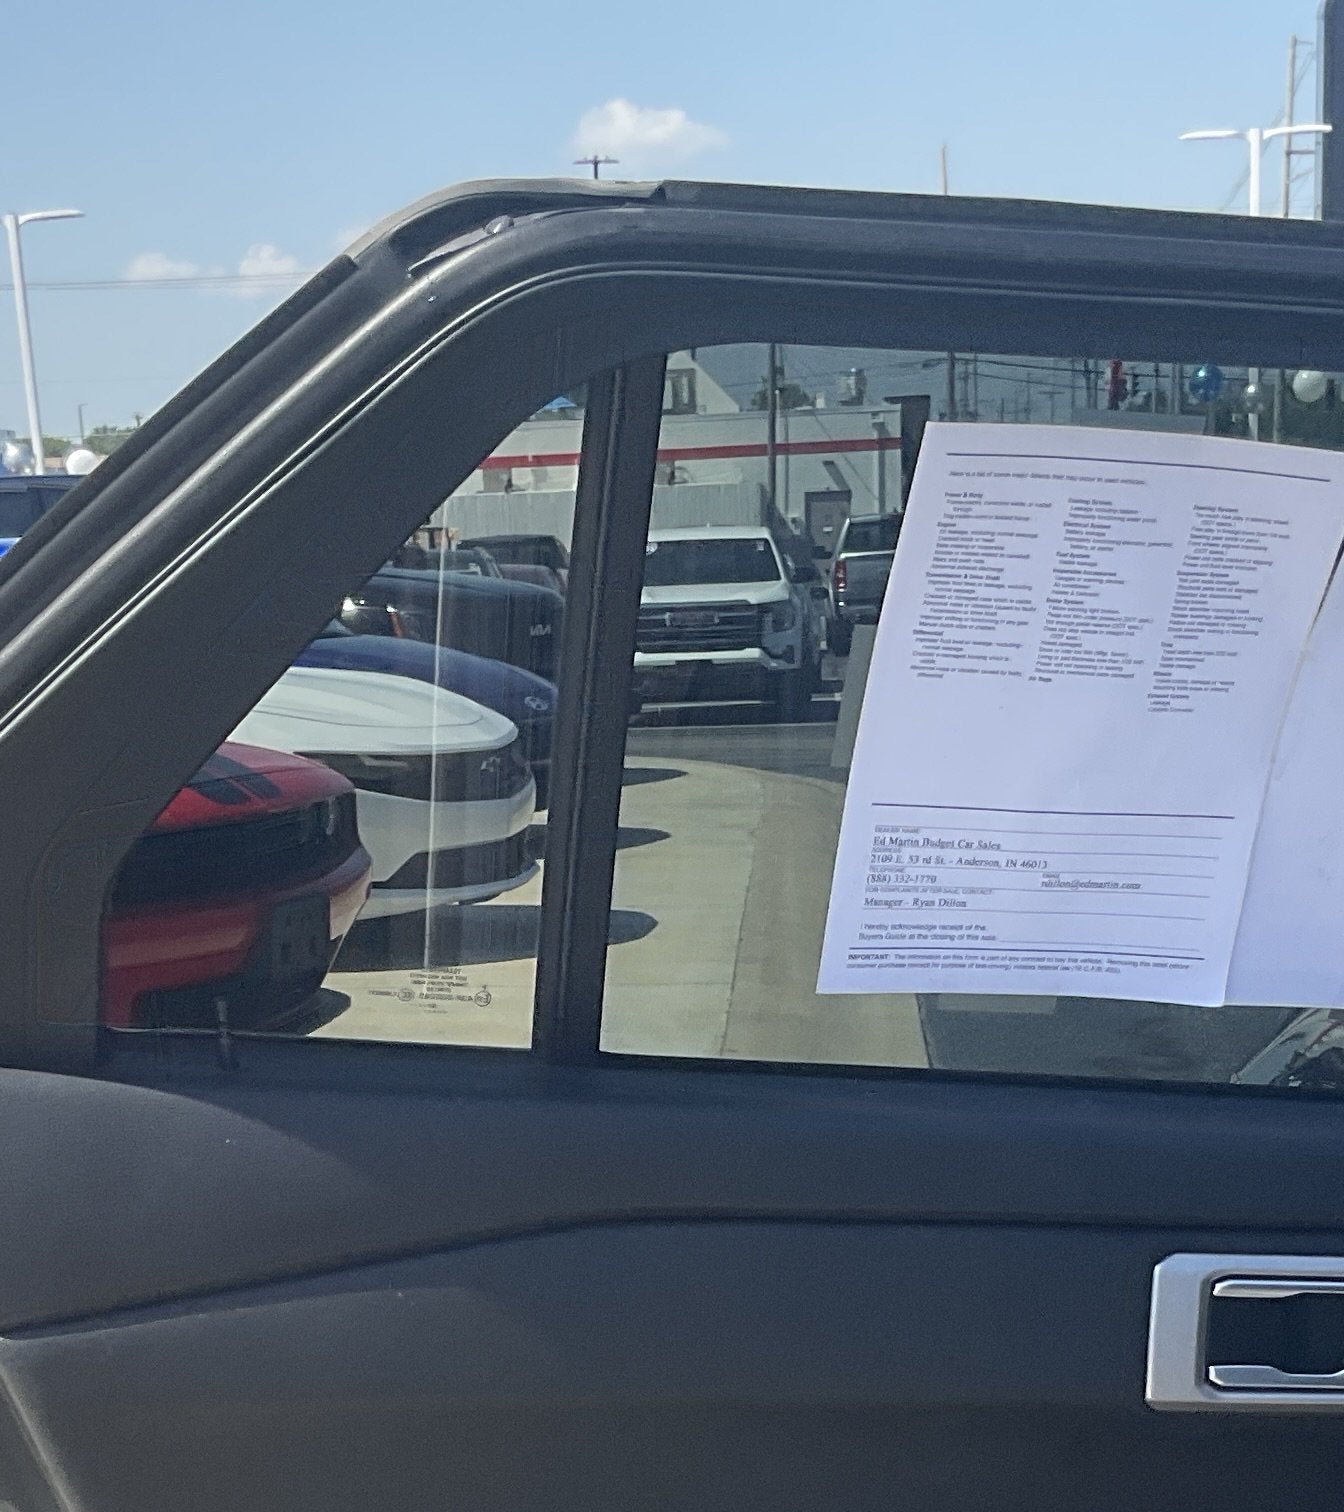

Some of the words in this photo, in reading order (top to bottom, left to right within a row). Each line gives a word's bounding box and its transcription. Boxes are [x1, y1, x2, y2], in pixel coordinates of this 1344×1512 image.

[873, 836, 886, 846] Ed
[888, 837, 920, 847] Martin
[921, 838, 955, 849] Budget
[957, 839, 975, 849] Car
[977, 840, 1001, 851] Sales
[870, 854, 893, 864] 2109
[955, 857, 1002, 868] Anderson,
[1005, 859, 1018, 868] IN
[863, 897, 904, 908] Manager
[912, 897, 936, 909] Ryan
[938, 898, 968, 908] Dillon
